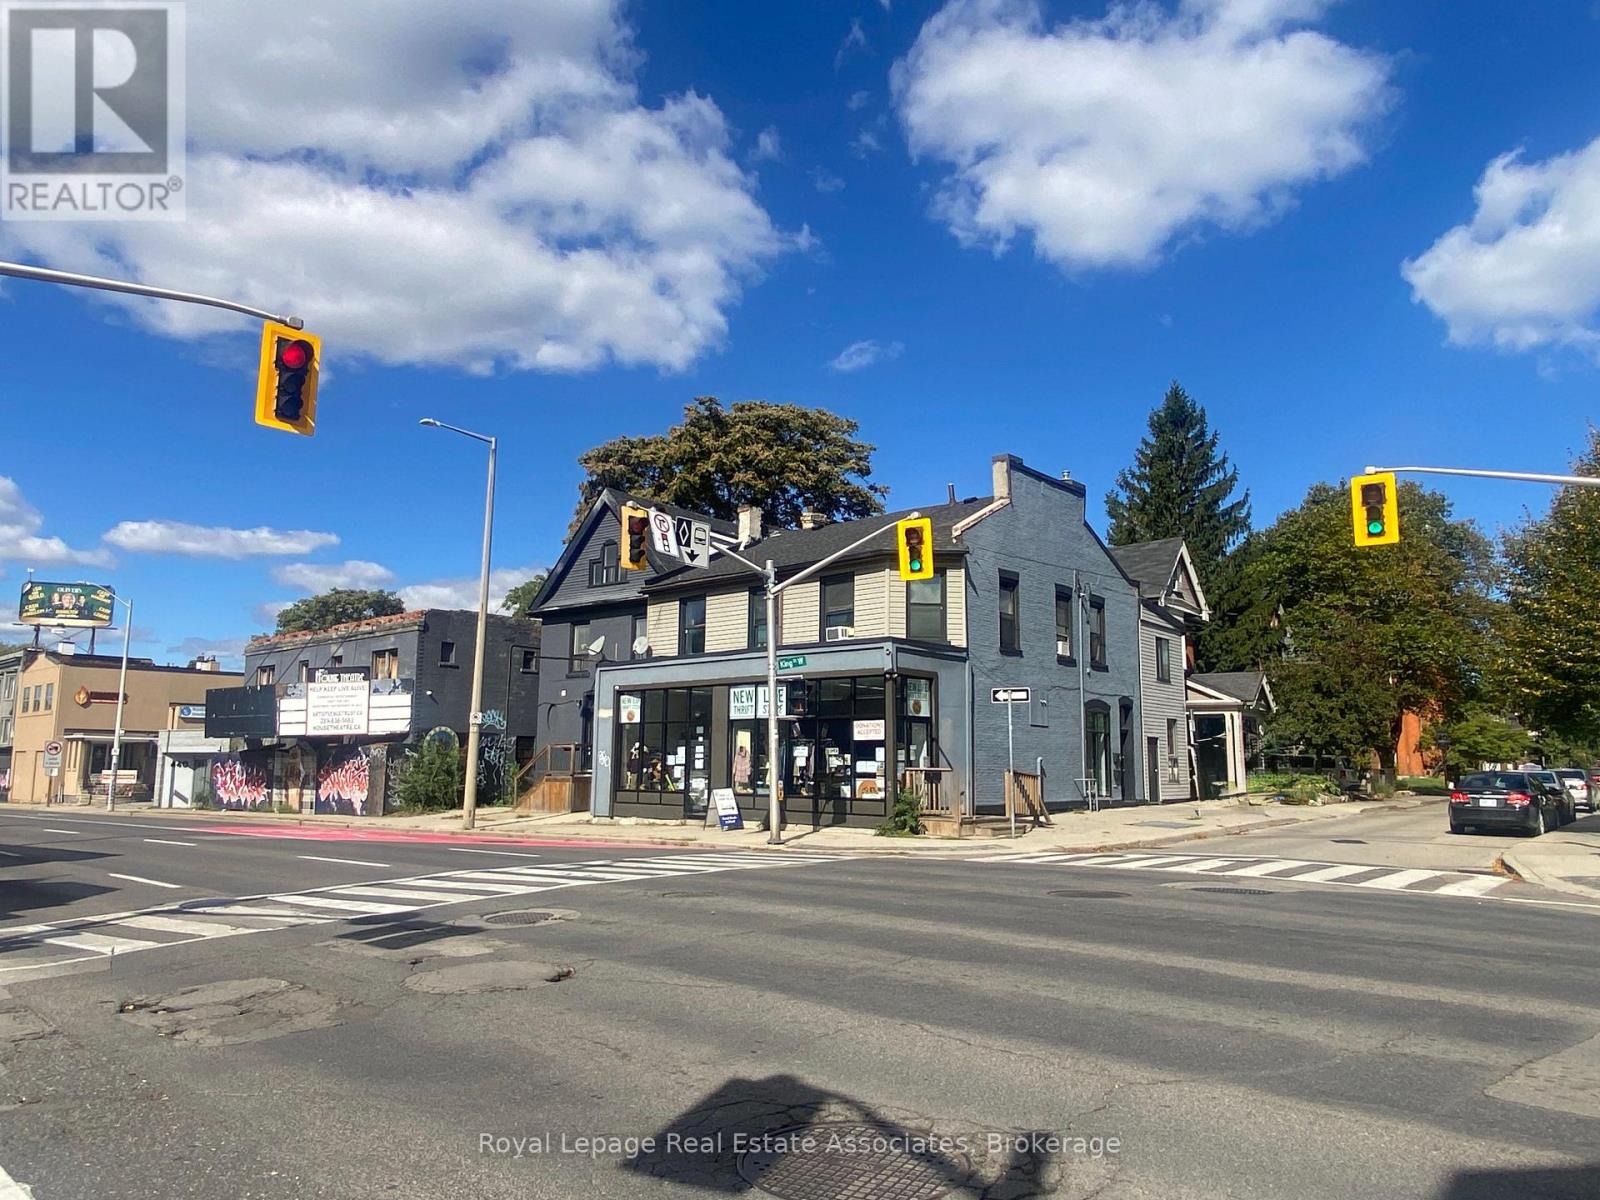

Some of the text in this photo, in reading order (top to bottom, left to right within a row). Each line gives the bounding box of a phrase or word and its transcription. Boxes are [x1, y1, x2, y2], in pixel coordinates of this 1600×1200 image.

[780, 660, 793, 668] King
[798, 657, 804, 665] W
[733, 689, 784, 704] NEW LE
[733, 704, 754, 715] THRIFT
